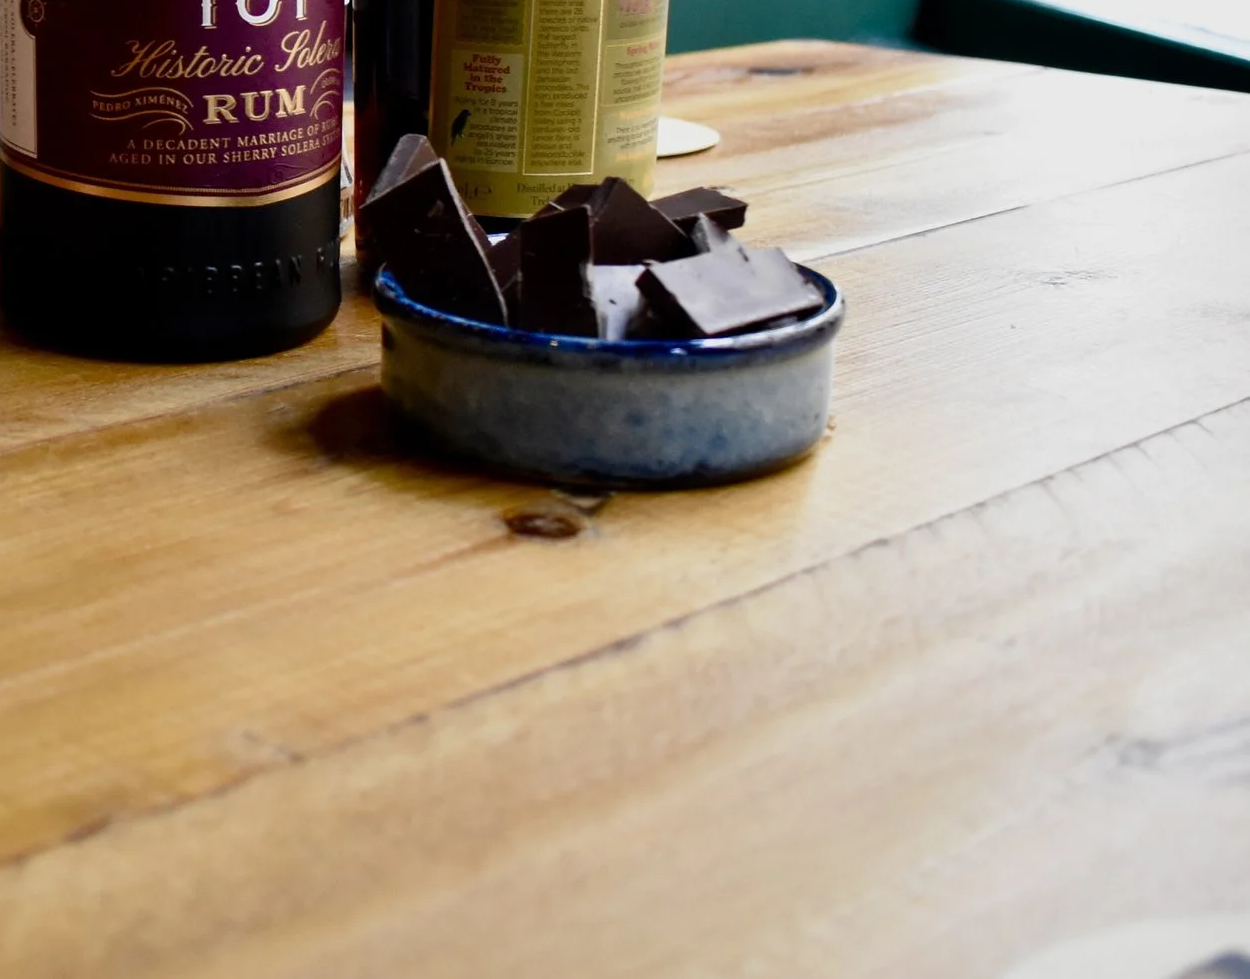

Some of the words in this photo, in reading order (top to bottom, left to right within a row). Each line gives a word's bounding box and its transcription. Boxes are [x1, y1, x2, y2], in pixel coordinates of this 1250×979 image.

[110, 39, 264, 79] Historic
[472, 54, 502, 66] Fully
[463, 62, 510, 74] Matured
[470, 73, 481, 82] in
[484, 74, 503, 83] the
[464, 81, 507, 94] Tropics
[92, 99, 131, 112] PEDRO
[202, 85, 306, 125] RUM
[126, 138, 136, 150] A
[143, 137, 232, 151] DECADENT
[237, 127, 304, 148] MARRIAGE
[307, 122, 320, 137] OF
[110, 153, 151, 165] AGED
[159, 153, 176, 165] IN
[183, 152, 218, 165] OUR
[223, 146, 277, 164] SHERRY
[281, 139, 320, 157] SOLERA
[517, 182, 556, 194] Distilled
